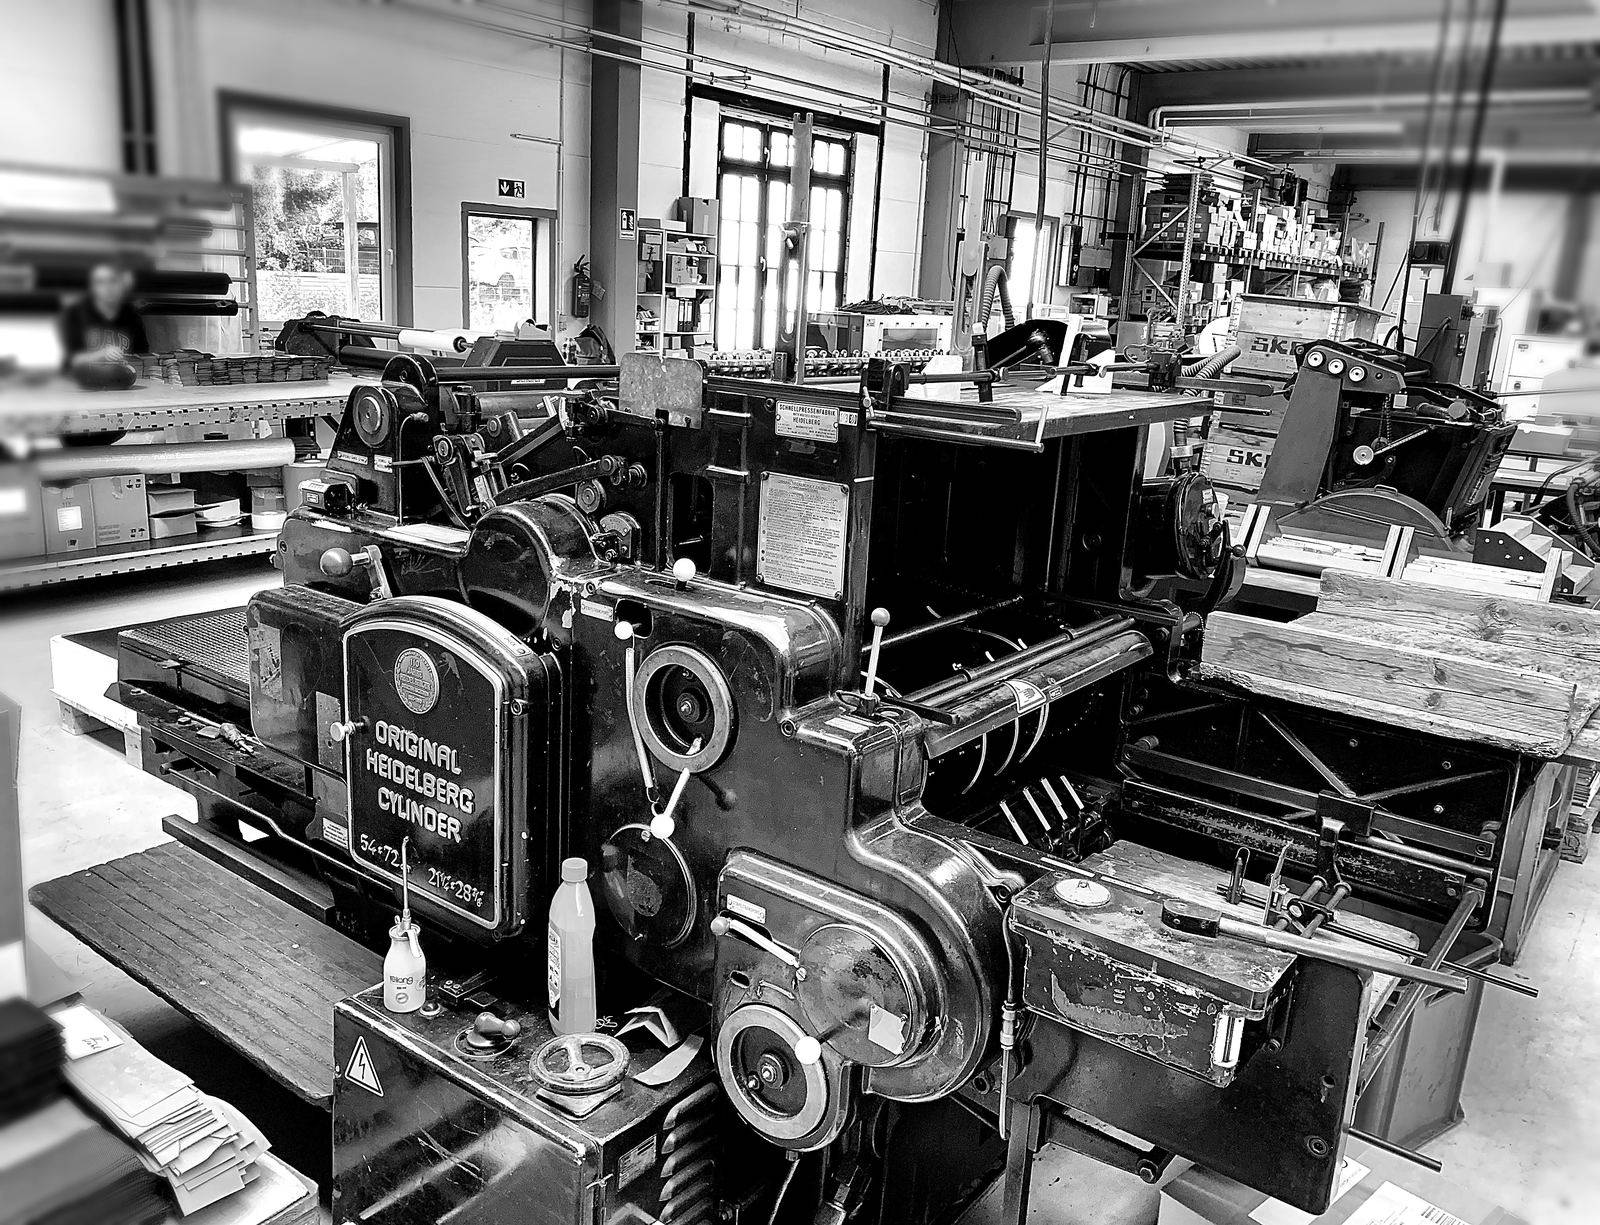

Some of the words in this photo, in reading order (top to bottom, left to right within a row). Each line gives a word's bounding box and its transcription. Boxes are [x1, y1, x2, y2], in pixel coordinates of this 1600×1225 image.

[779, 404, 836, 416] SCHNELLPRESSENFABRIK
[792, 416, 821, 426] HEIDELBERG
[1227, 449, 1271, 469] SK
[375, 720, 462, 775] ORIGINAL
[366, 748, 475, 814] HEIDELBERG
[377, 786, 462, 844] CYLINDER
